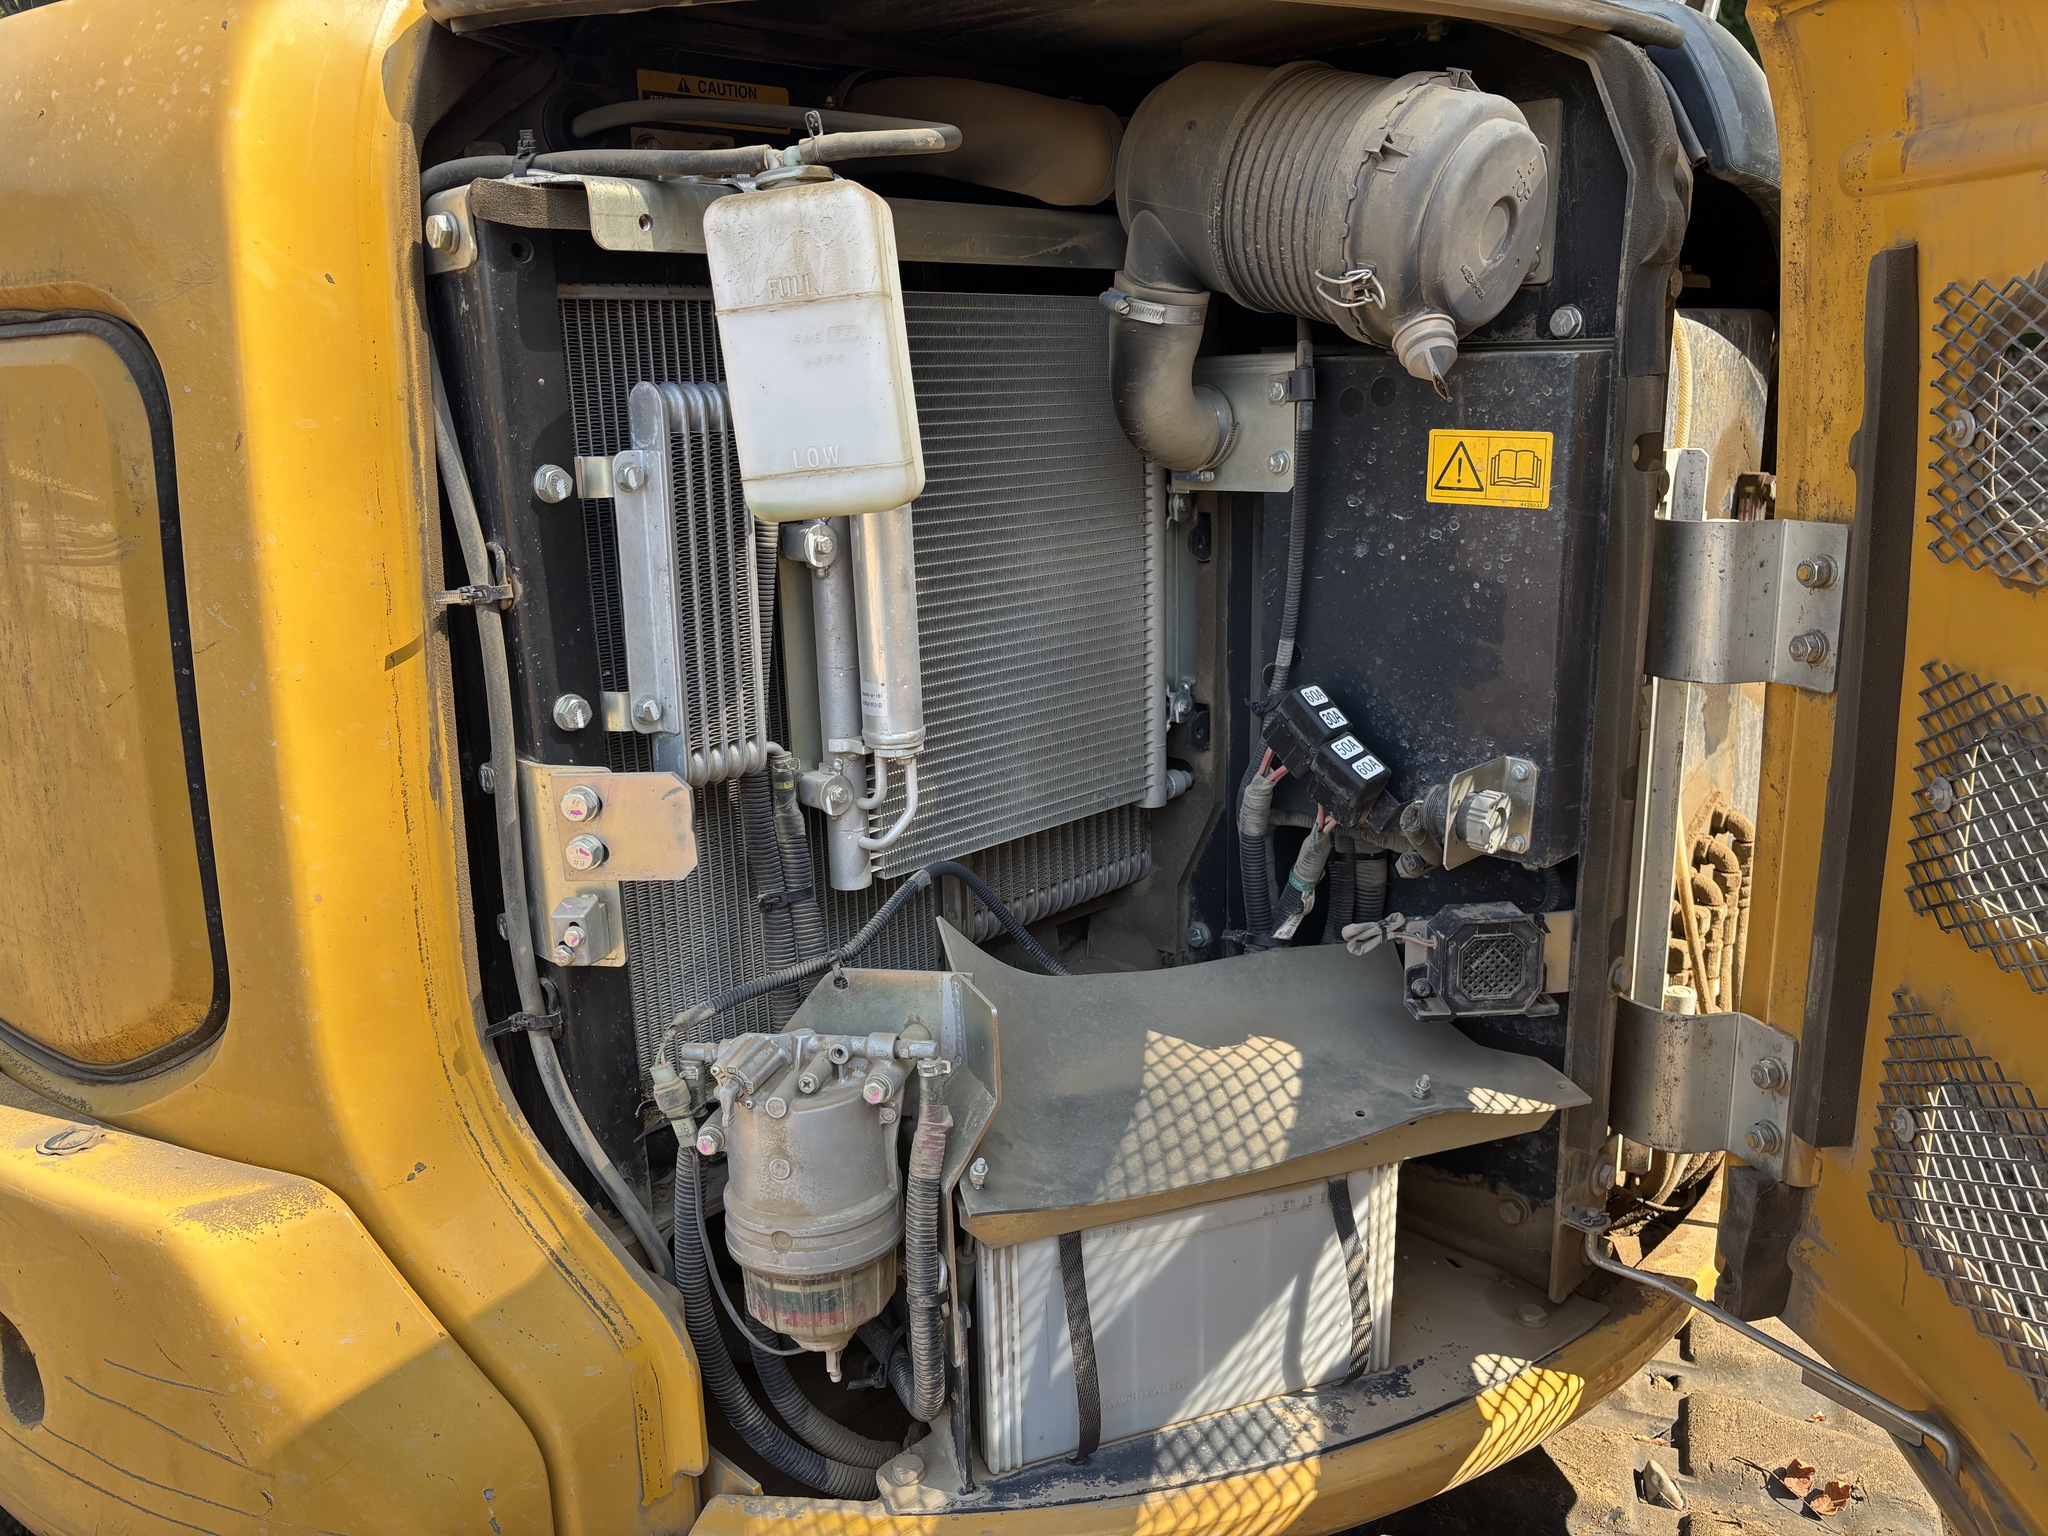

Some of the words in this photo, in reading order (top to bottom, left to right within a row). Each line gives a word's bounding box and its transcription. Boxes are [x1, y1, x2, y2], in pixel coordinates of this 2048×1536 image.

[697, 79, 758, 100] CAUTION
[767, 273, 817, 300] FULL
[793, 445, 840, 470] LOW
[1304, 688, 1326, 703] 60A
[1322, 709, 1345, 726] 30A
[1334, 738, 1360, 755] 50A
[1355, 758, 1381, 776] 60A
